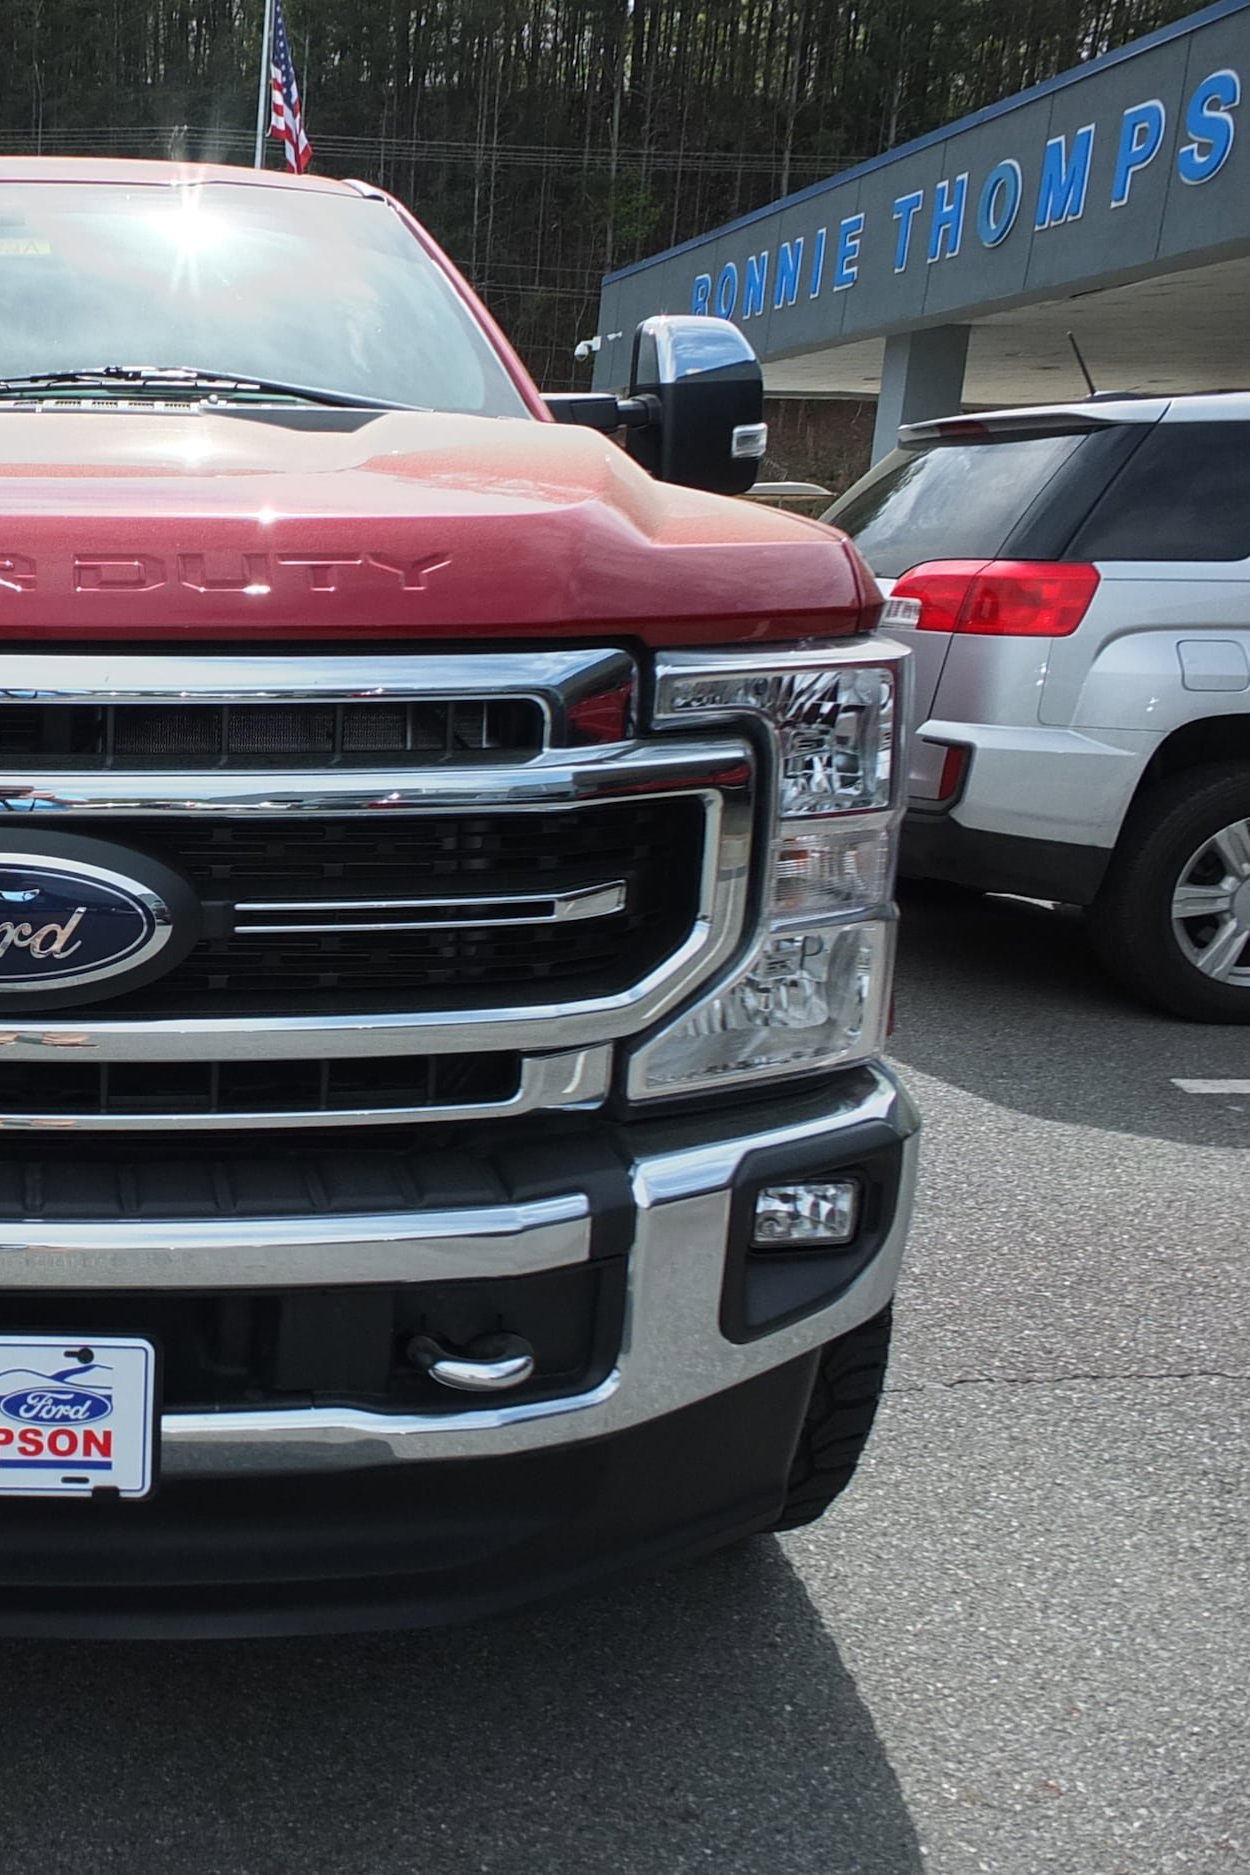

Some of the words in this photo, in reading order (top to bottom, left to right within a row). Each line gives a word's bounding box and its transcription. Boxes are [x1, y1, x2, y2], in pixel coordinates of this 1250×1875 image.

[690, 212, 865, 320] RONNIE
[892, 68, 1241, 274] THOMPS
[72, 552, 453, 592] DUTY
[17, 1391, 92, 1421] Ford
